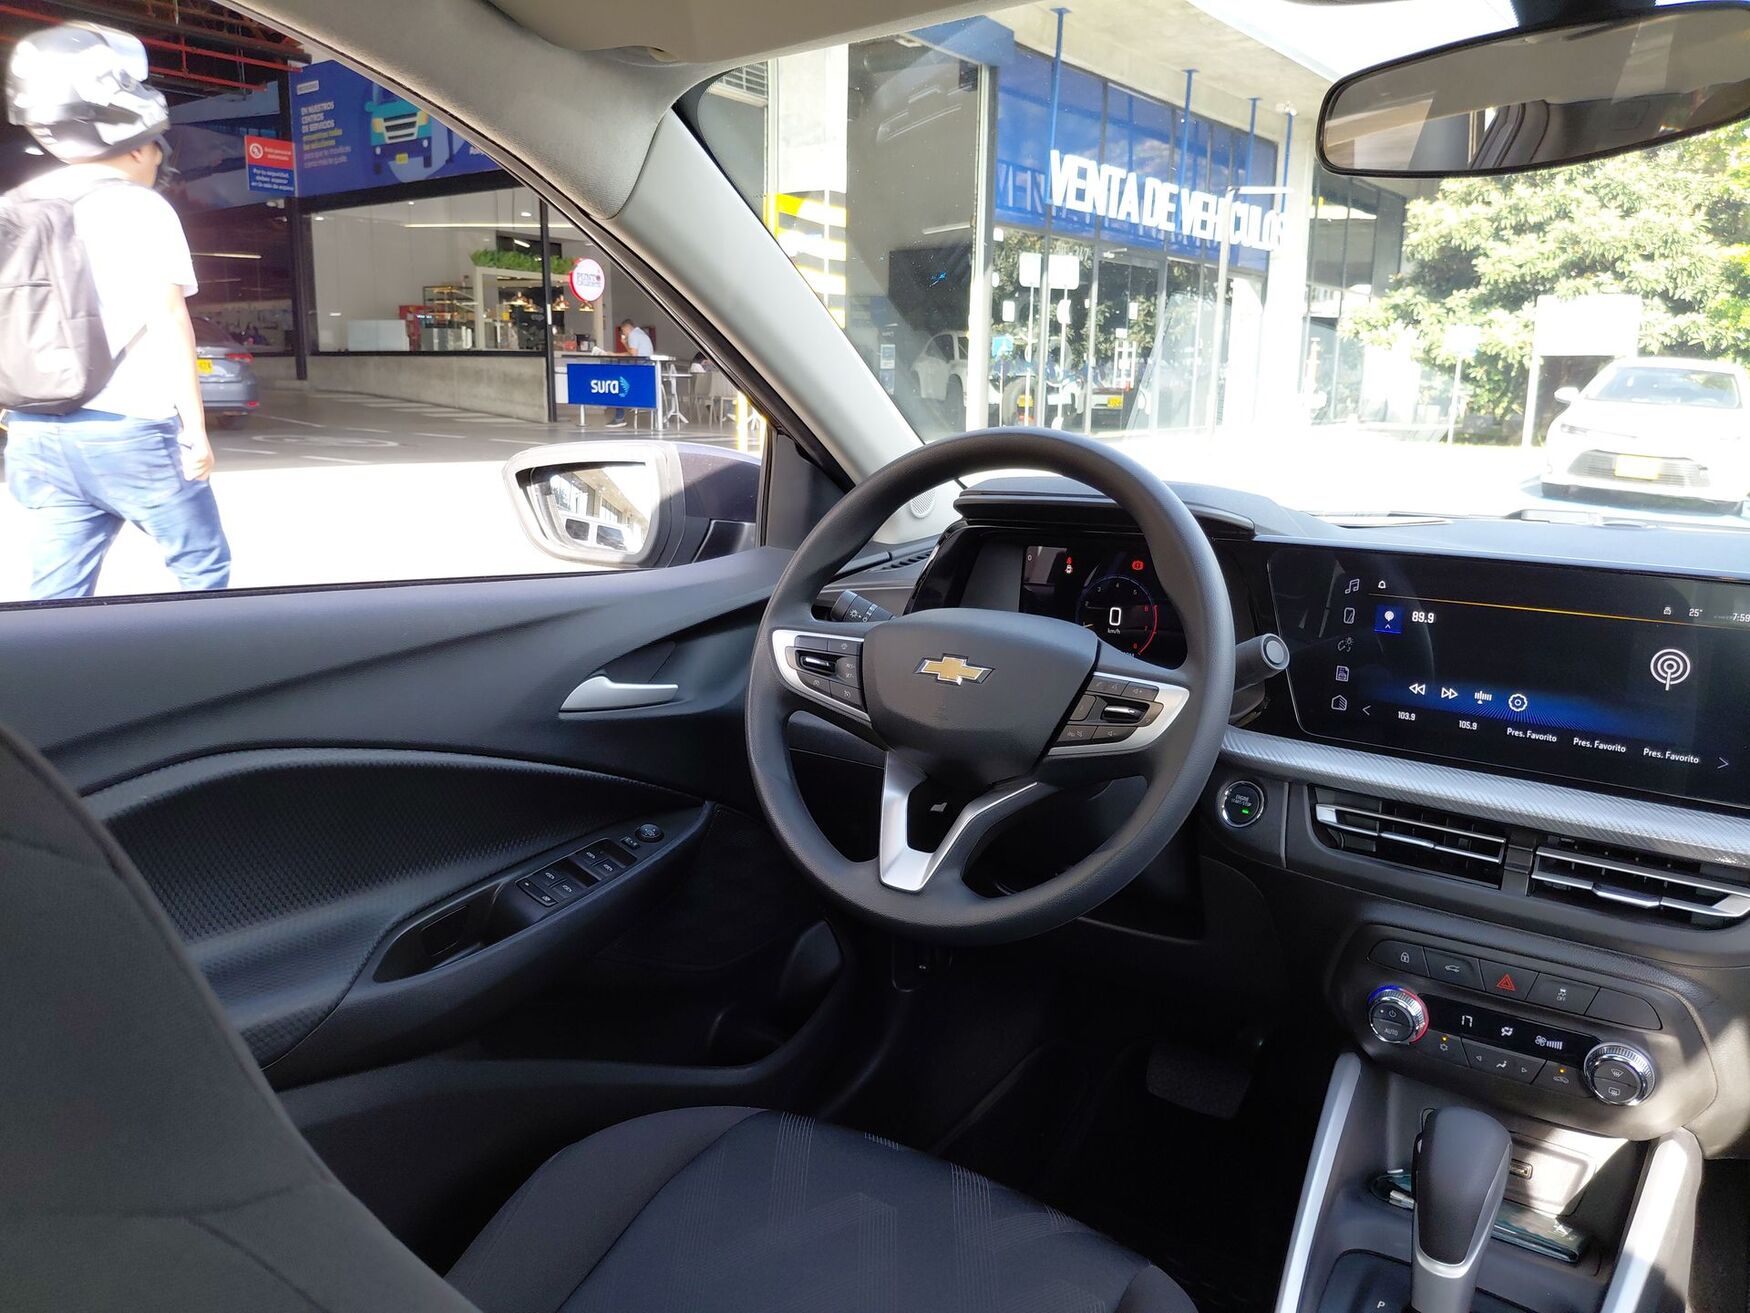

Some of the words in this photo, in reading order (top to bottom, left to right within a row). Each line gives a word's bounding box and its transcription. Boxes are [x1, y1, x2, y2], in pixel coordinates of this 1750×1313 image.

[1050, 149, 1140, 223] VENTA
[1141, 176, 1179, 232] DE
[1180, 187, 1287, 252] VEHCULOS
[590, 379, 619, 394] sura
[1109, 606, 1122, 627] 0
[1411, 610, 1435, 624] 89.9
[1688, 607, 1703, 617] 25°
[1397, 711, 1416, 721] 103.9
[1458, 720, 1478, 731] 105.9
[1506, 727, 1525, 738] Pres.
[1526, 730, 1557, 743] Favorito
[1573, 737, 1593, 748] Pres.
[1594, 740, 1626, 753] Favorito
[1643, 748, 1664, 759] Pres.
[1665, 751, 1699, 764] Favorito
[1461, 1015, 1473, 1028] 17
[1376, 1300, 1386, 1309] P
